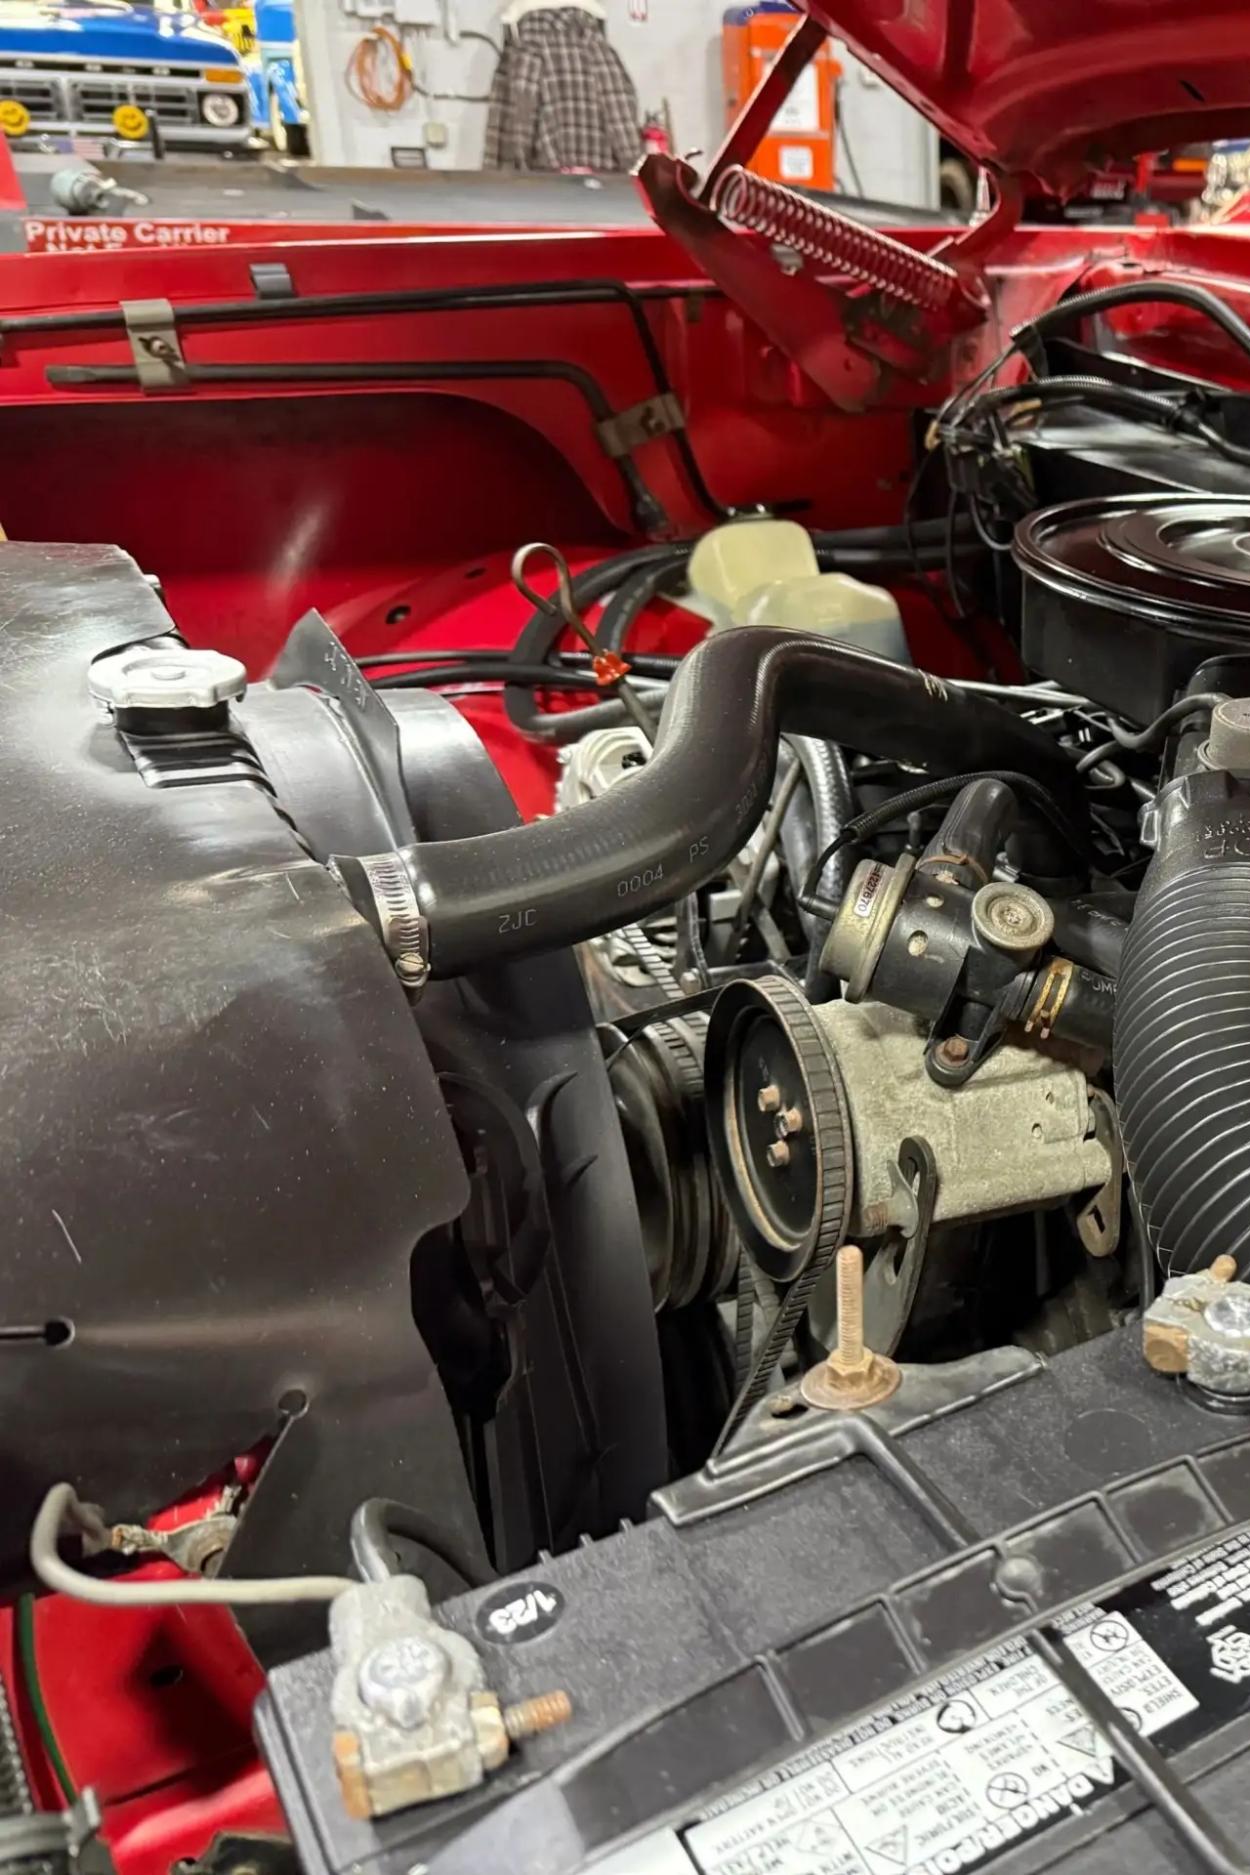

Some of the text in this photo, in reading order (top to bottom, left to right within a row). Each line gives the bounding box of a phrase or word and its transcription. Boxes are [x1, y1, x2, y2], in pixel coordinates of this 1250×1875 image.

[25, 222, 229, 243] Private Carrier
[488, 1589, 557, 1635] 1/23
